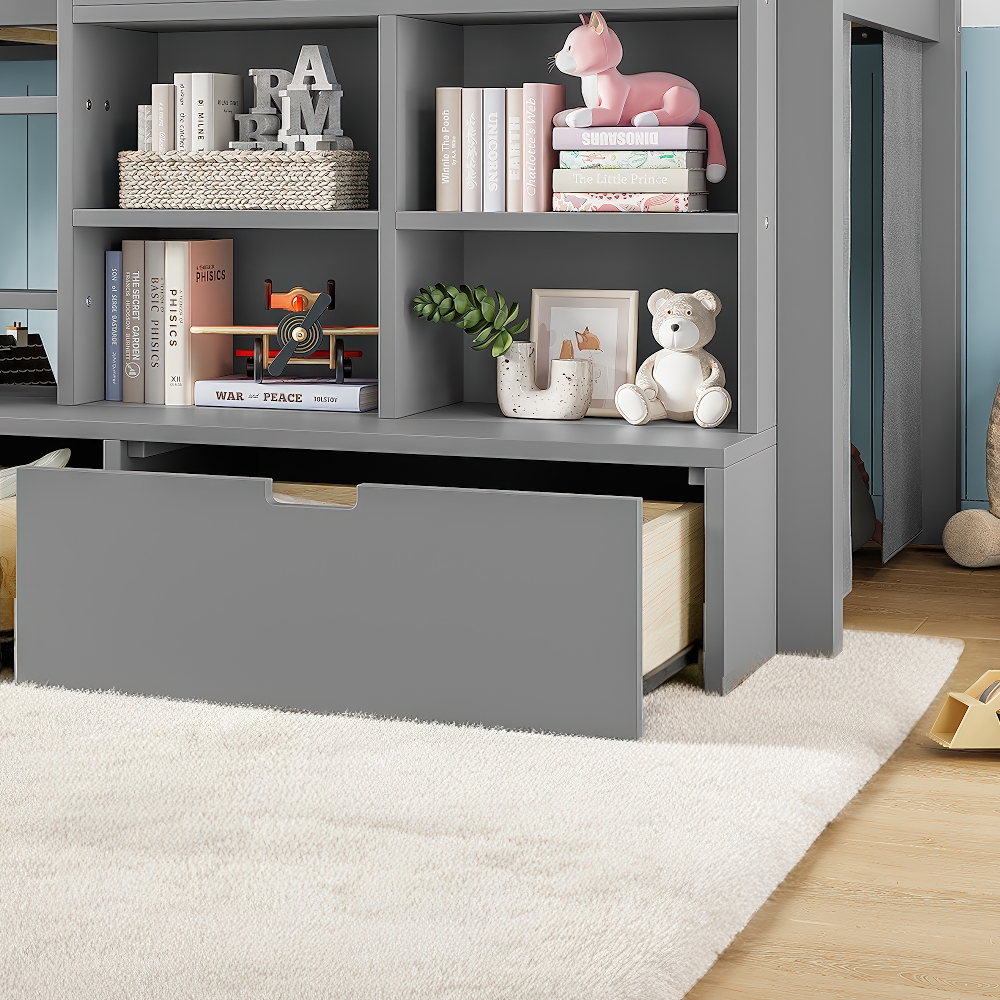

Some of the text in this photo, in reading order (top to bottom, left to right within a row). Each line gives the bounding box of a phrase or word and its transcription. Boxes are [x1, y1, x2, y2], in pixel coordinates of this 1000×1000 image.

[442, 109, 450, 132] Pooh
[525, 97, 537, 124] Web
[197, 112, 205, 140] MILNE
[581, 131, 659, 146] DINOSAURS
[488, 112, 498, 192] UNICORNS
[509, 116, 520, 181] EARTH
[573, 173, 668, 185] The Little Prince
[196, 269, 226, 283] PHISICS
[132, 270, 140, 361] THE SECRET GARDEN
[151, 277, 159, 368] BASIC PHISICS
[169, 289, 178, 347] PHISICS
[215, 391, 245, 401] WAR
[263, 392, 303, 403] PEACE
